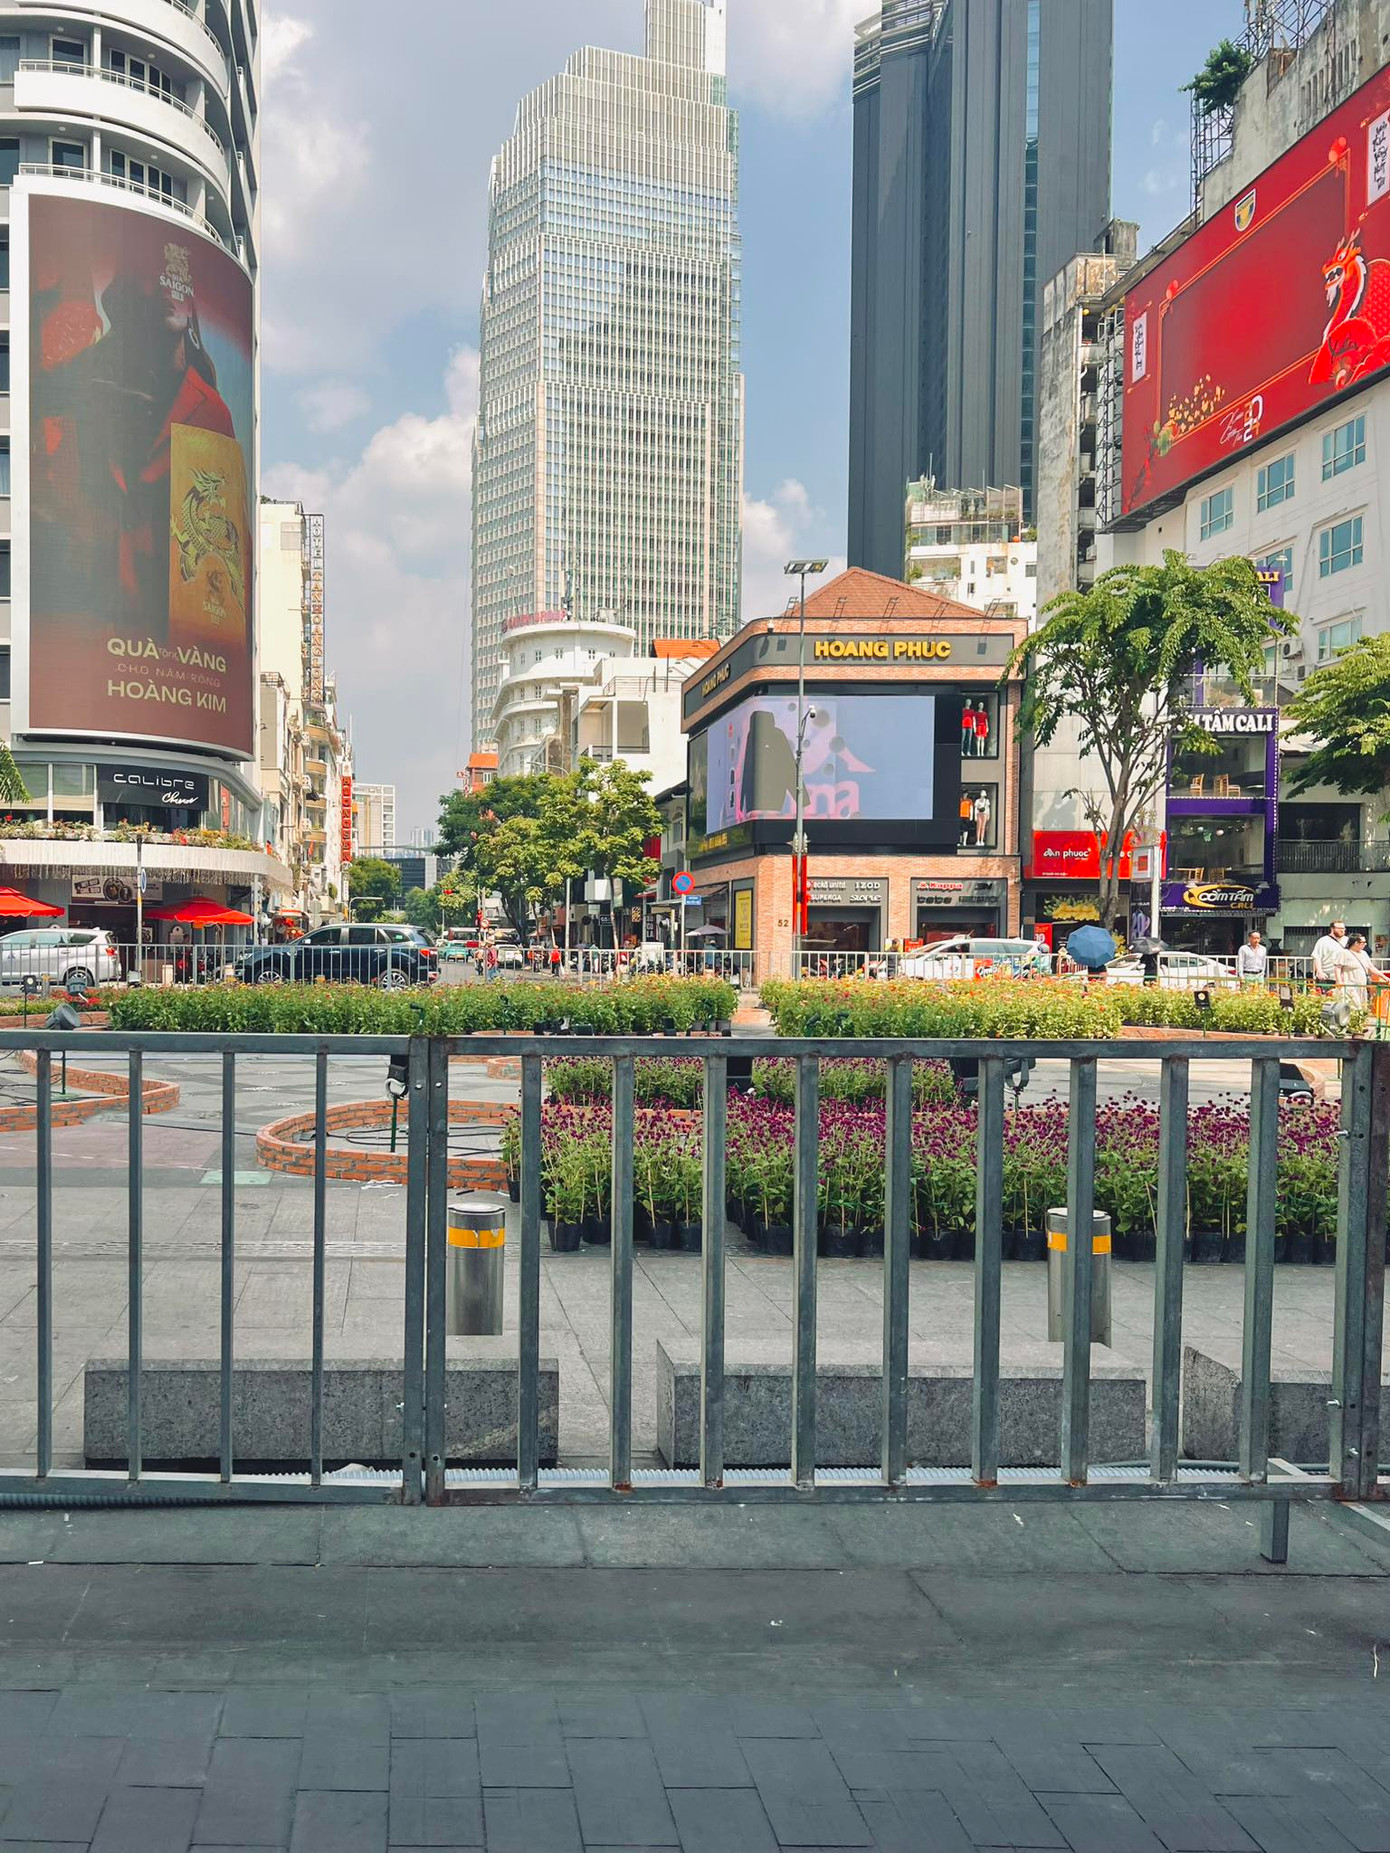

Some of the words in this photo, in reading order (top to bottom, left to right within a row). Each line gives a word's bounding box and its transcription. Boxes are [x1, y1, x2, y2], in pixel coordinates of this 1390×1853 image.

[159, 275, 195, 297] SAIGON
[107, 637, 160, 660] QUÀ
[177, 645, 227, 673] VÀNG
[814, 640, 890, 660] HOANG
[893, 640, 952, 661] PHUC
[107, 678, 193, 706] HOÀNG
[196, 691, 227, 713] KIM
[1235, 714, 1273, 732] CALI
[854, 881, 881, 890] IZOD
[777, 919, 789, 927] 52
